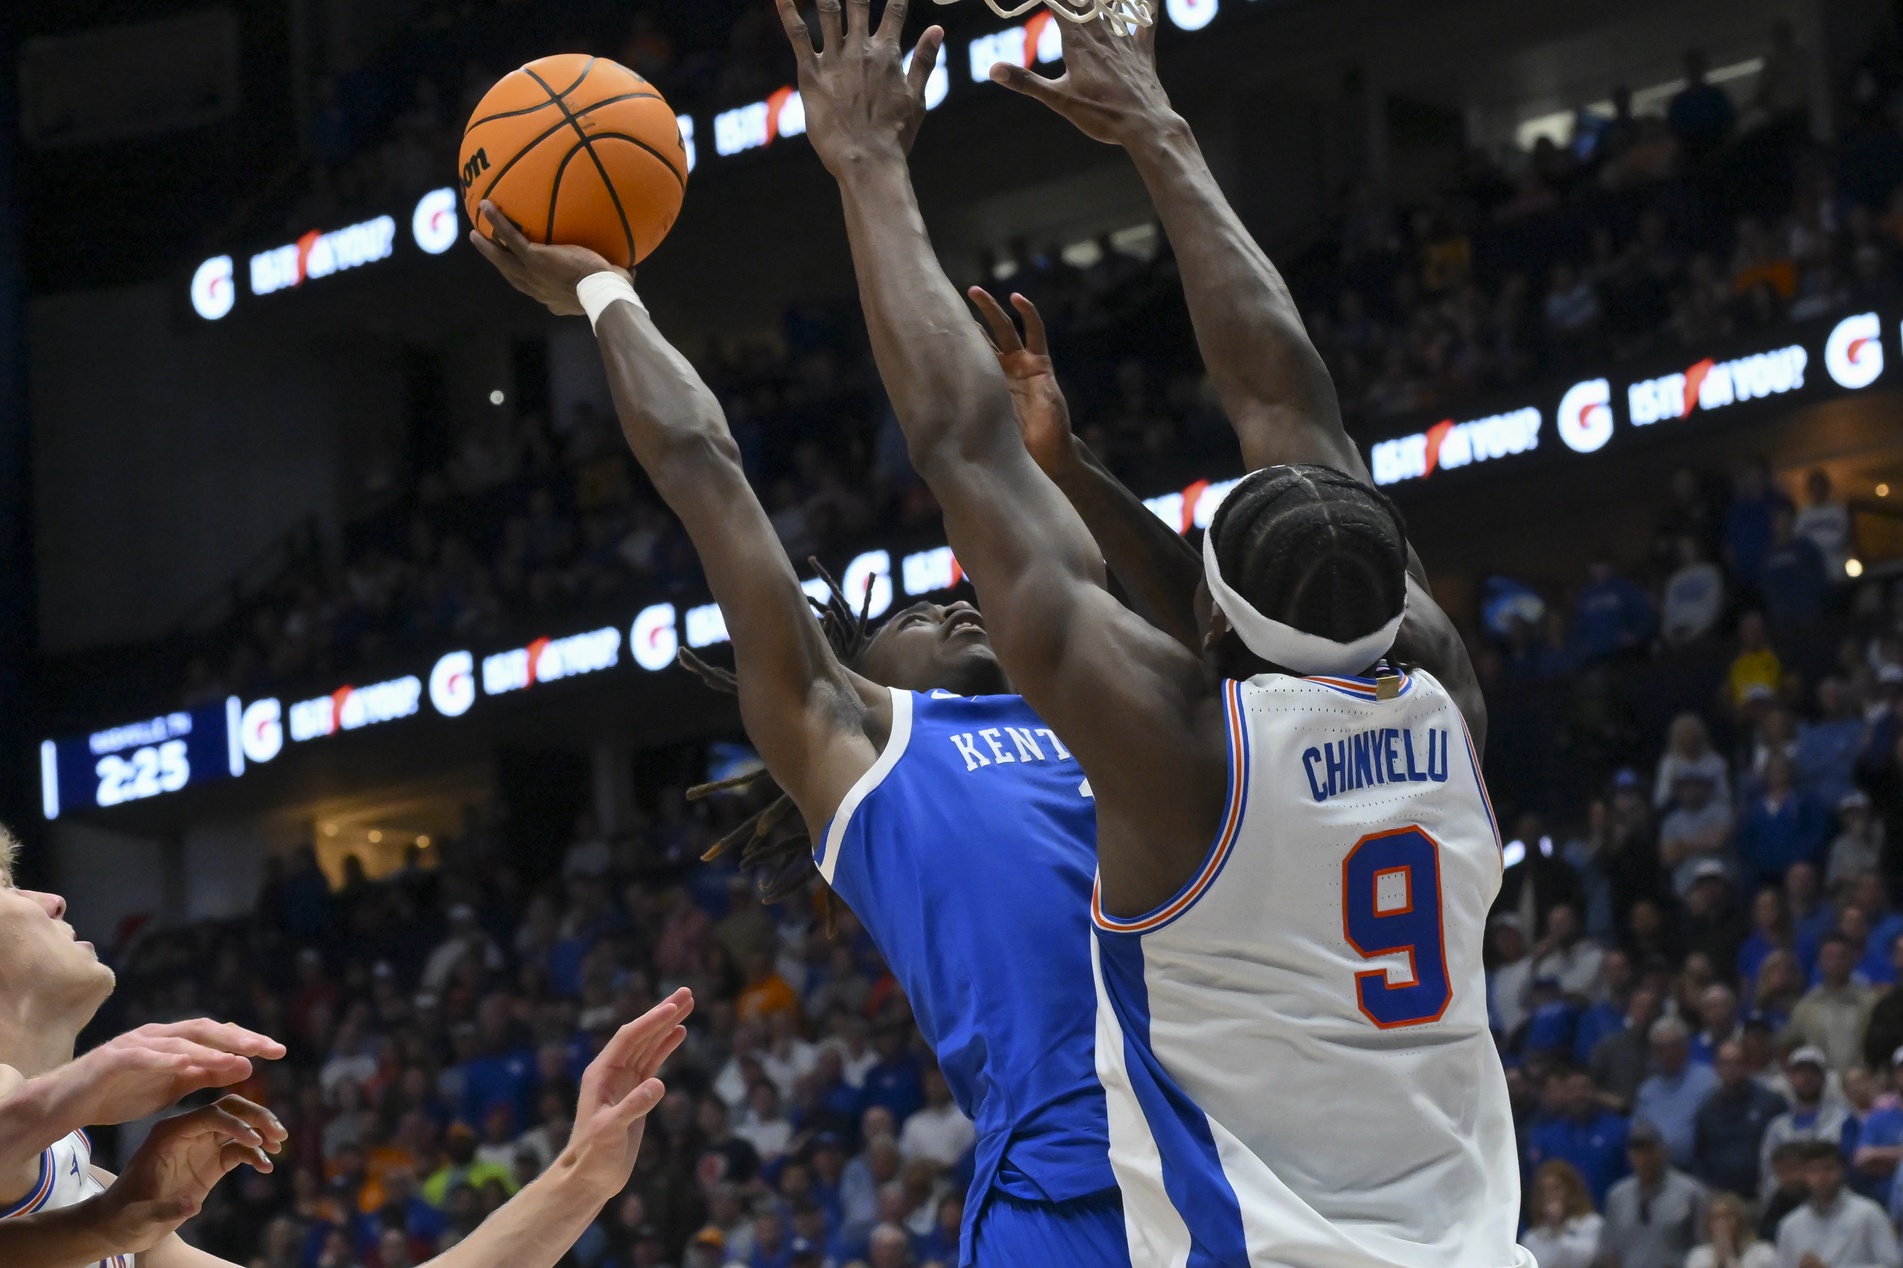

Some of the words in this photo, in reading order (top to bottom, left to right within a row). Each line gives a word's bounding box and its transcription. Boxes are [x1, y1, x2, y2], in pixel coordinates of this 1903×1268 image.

[413, 187, 458, 254] G
[192, 255, 234, 320] G
[1825, 313, 1883, 389] G
[1558, 378, 1613, 453] G
[842, 550, 892, 619] G
[630, 603, 677, 670] G
[430, 651, 474, 716] G
[241, 698, 282, 762] G
[950, 727, 1071, 772] KENT
[96, 740, 189, 806] 2:25
[1302, 728, 1447, 802] CHINYELU
[1342, 824, 1453, 1030] 9
